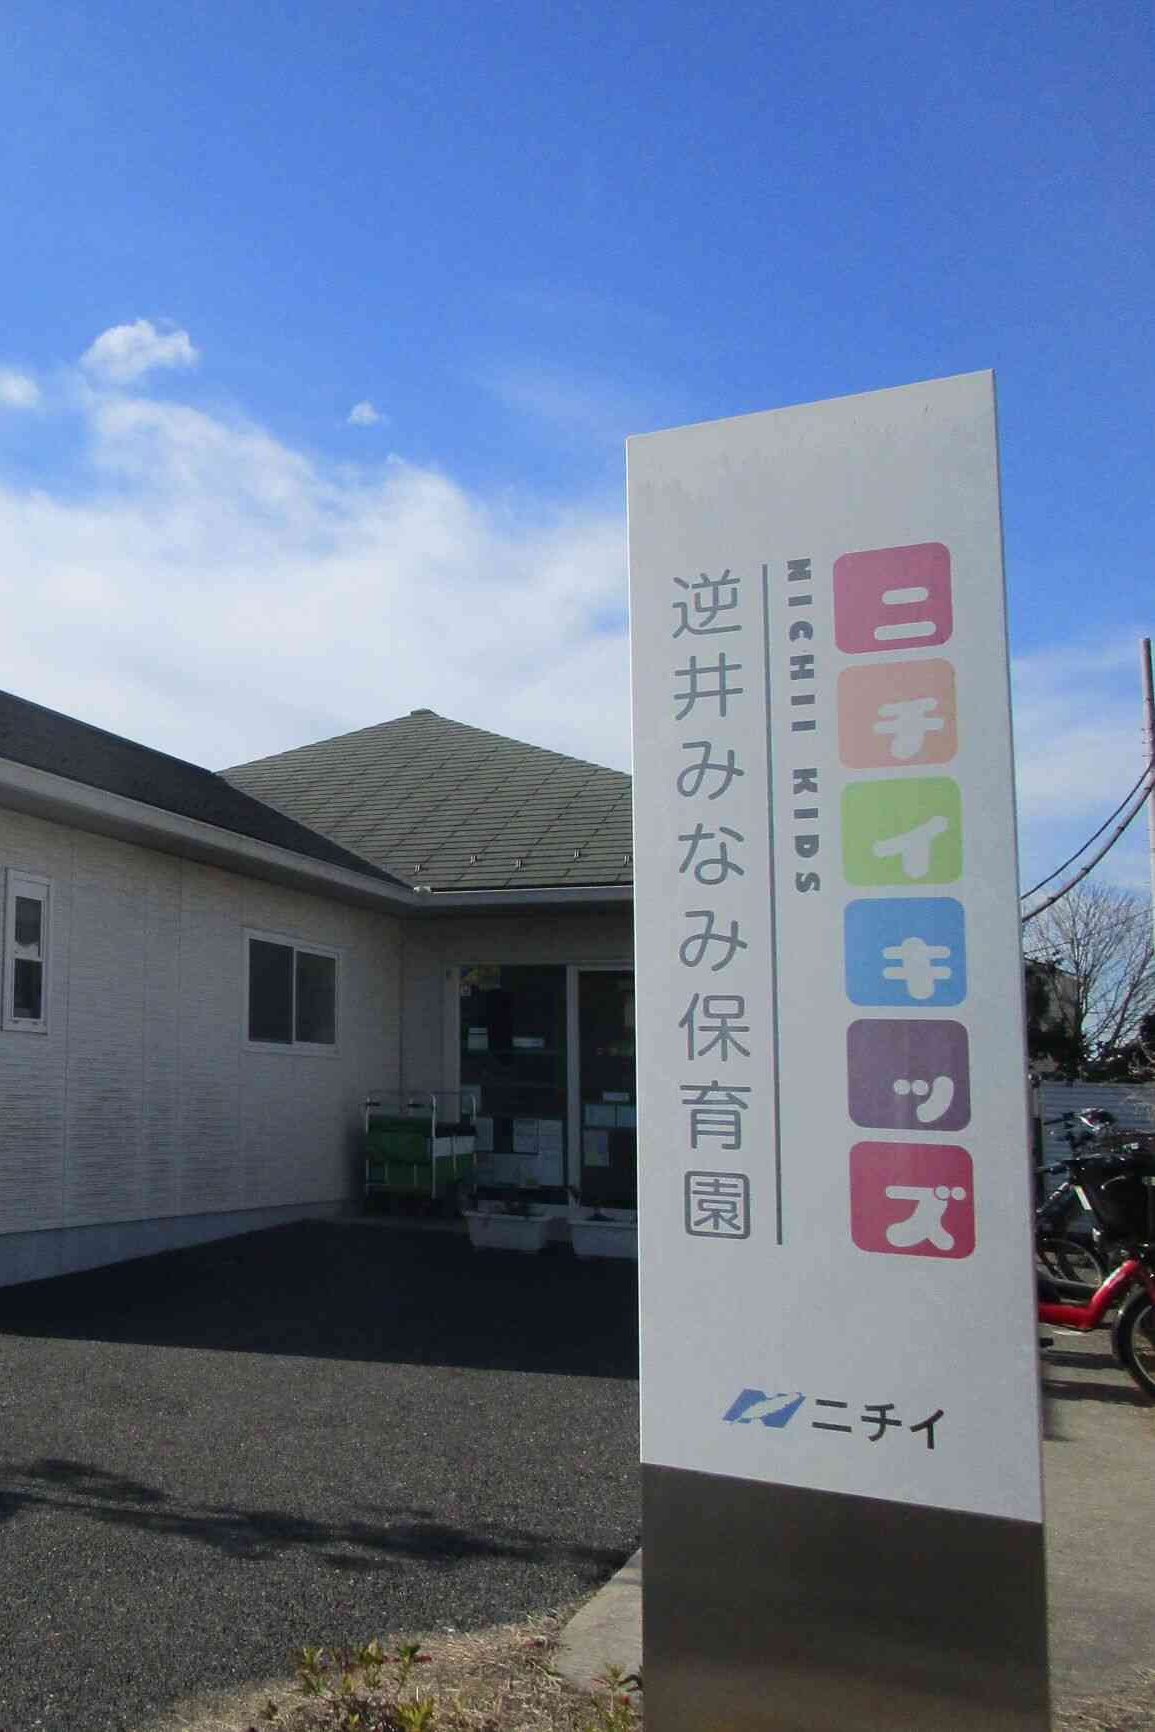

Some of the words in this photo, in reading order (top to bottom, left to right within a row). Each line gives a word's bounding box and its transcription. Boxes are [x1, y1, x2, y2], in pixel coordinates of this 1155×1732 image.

[786, 557, 816, 732] NICHII
[671, 568, 751, 1240] 逆井みなみ保育園
[792, 767, 821, 893] KIDS
[871, 584, 967, 1251] ニチイキッズ
[811, 1398, 945, 1450] ニチイ
